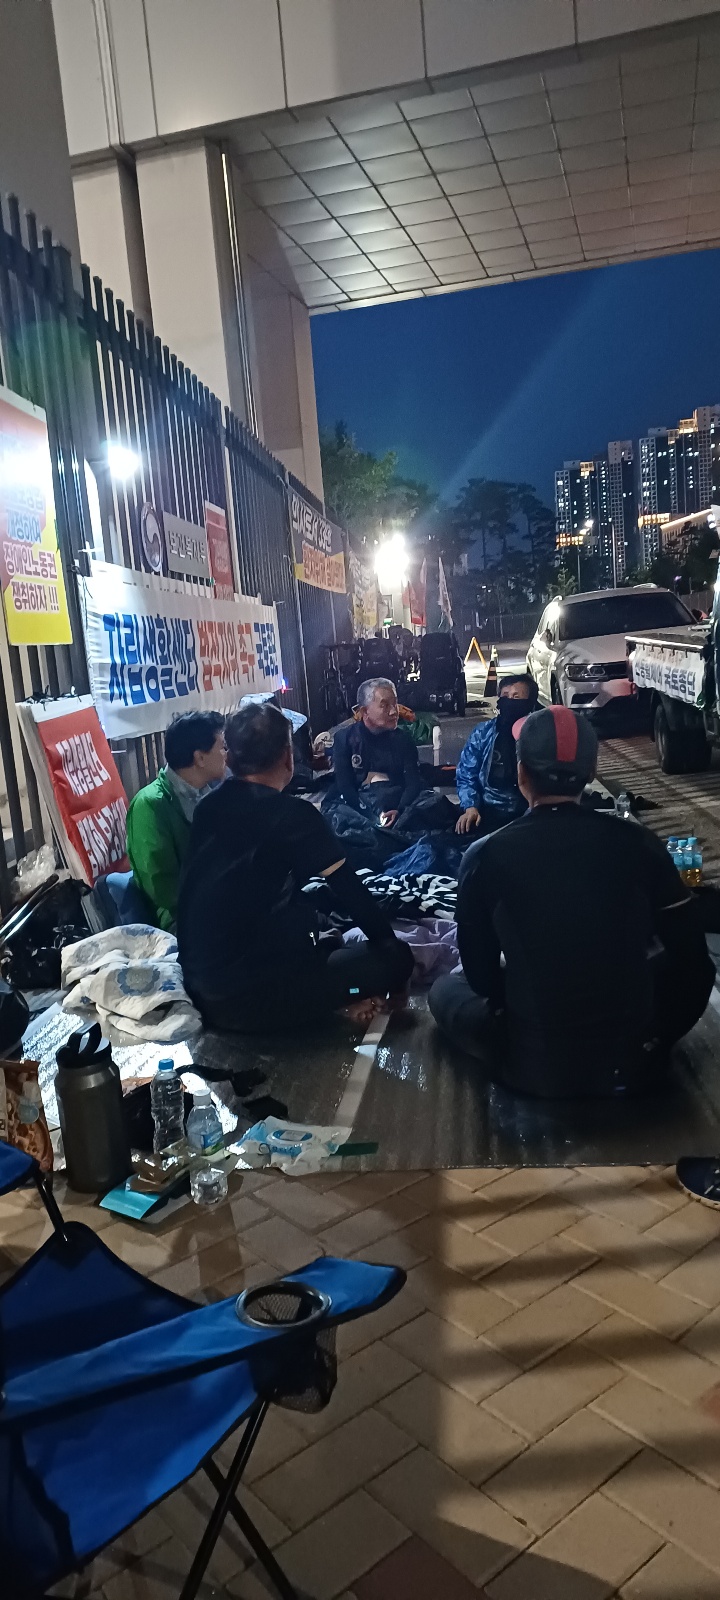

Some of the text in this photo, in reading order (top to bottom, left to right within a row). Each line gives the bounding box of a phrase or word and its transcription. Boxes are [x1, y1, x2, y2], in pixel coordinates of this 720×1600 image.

[3, 543, 58, 579] 장애인노동권
[169, 530, 207, 565] 보건복지부
[11, 582, 60, 611] 쟁취하자 !!!
[103, 612, 279, 706] 자립생활센터 법적지위 촉구 국토종단
[664, 665, 696, 697] 국토종단
[56, 730, 112, 797] 자립생활센터
